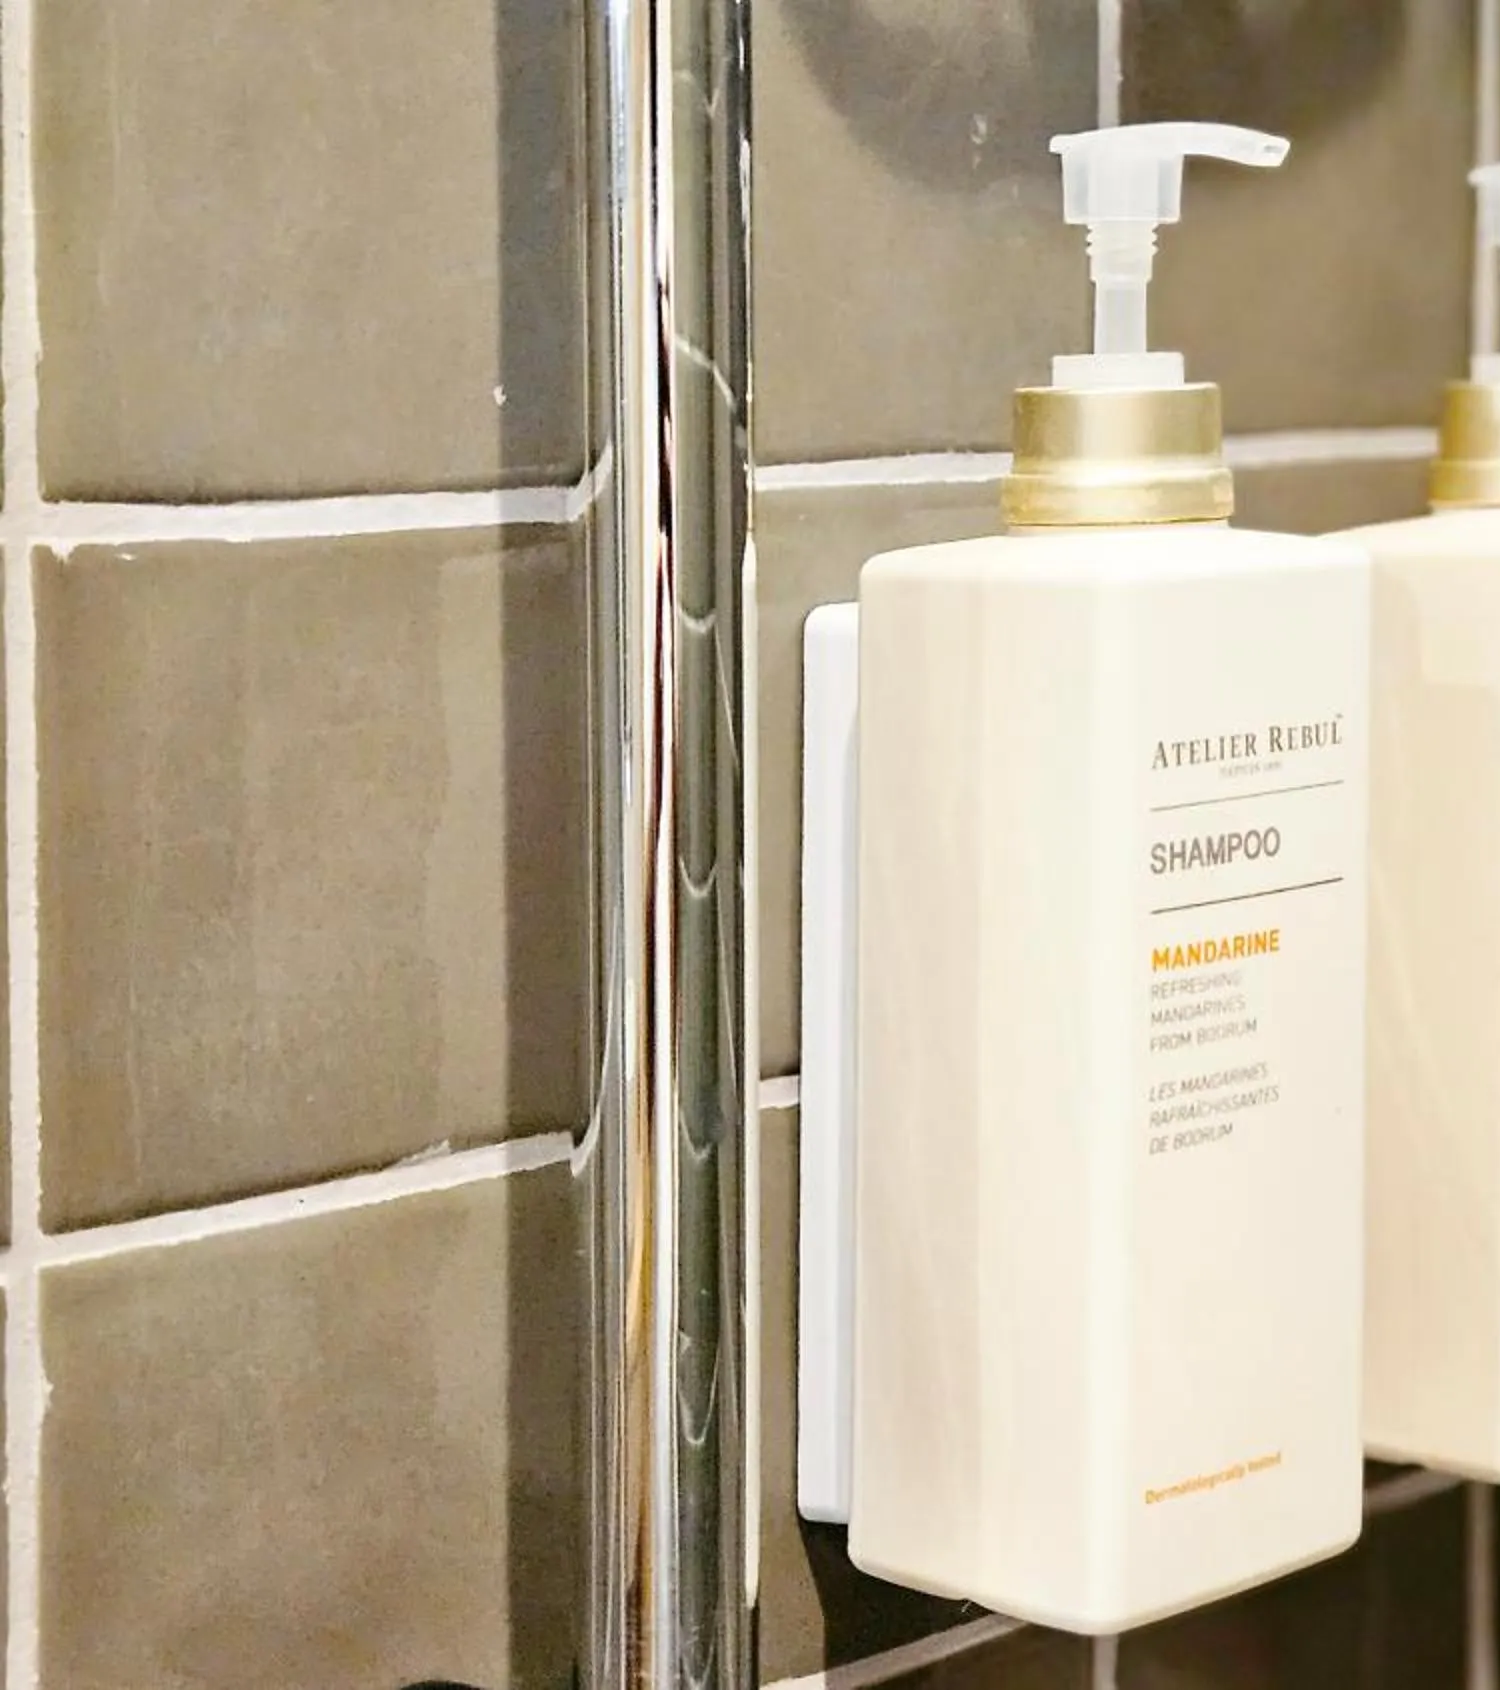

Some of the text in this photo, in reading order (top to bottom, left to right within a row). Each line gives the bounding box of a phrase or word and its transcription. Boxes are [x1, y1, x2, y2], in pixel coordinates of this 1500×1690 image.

[1151, 732, 1257, 770] ATELIER
[1150, 826, 1281, 875] SHAMPOO
[1152, 929, 1281, 972] MANDARINE
[1150, 970, 1242, 1001] REFRESHING
[1150, 994, 1247, 1026] MANDARINES
[1150, 1031, 1191, 1051] FROM
[1149, 1081, 1176, 1102] LES
[1149, 1135, 1168, 1155] DE
